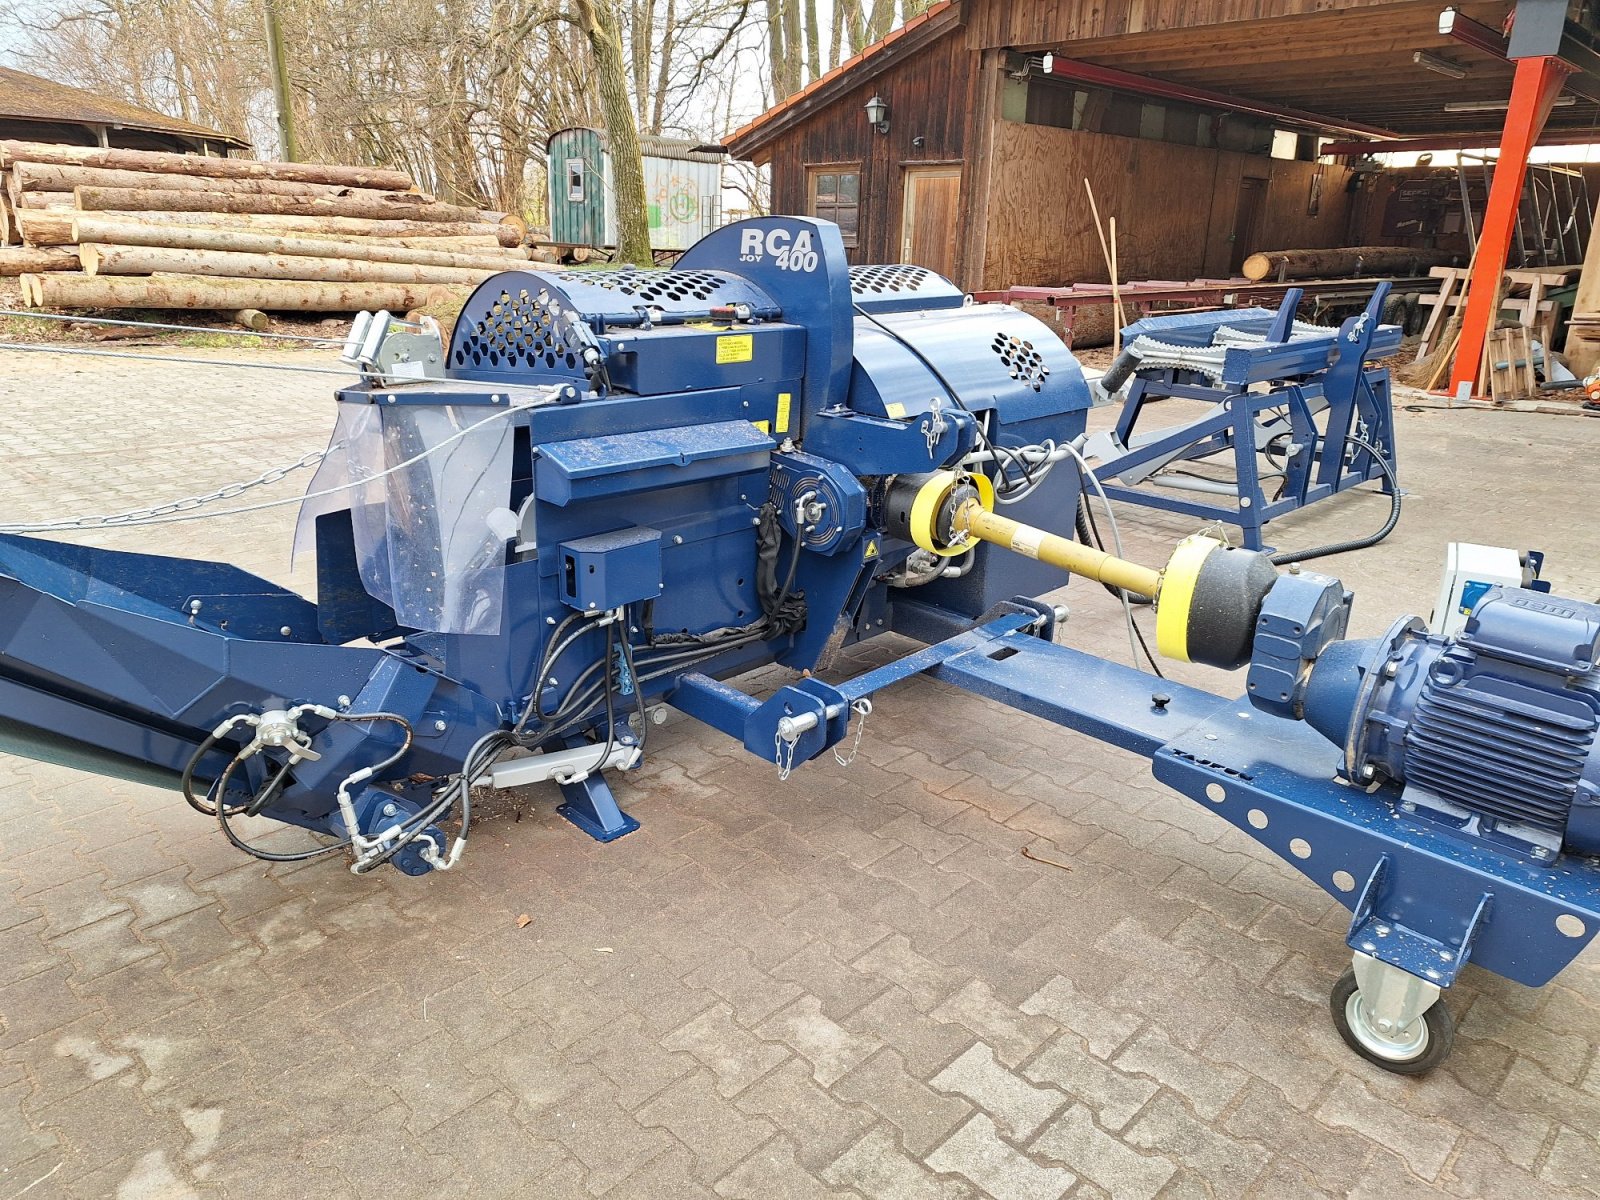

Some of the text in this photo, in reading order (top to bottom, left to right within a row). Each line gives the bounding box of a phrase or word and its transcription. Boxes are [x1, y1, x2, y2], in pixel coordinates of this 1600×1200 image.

[741, 229, 812, 256] RCA
[739, 254, 763, 262] JOY
[776, 250, 818, 272] 400
